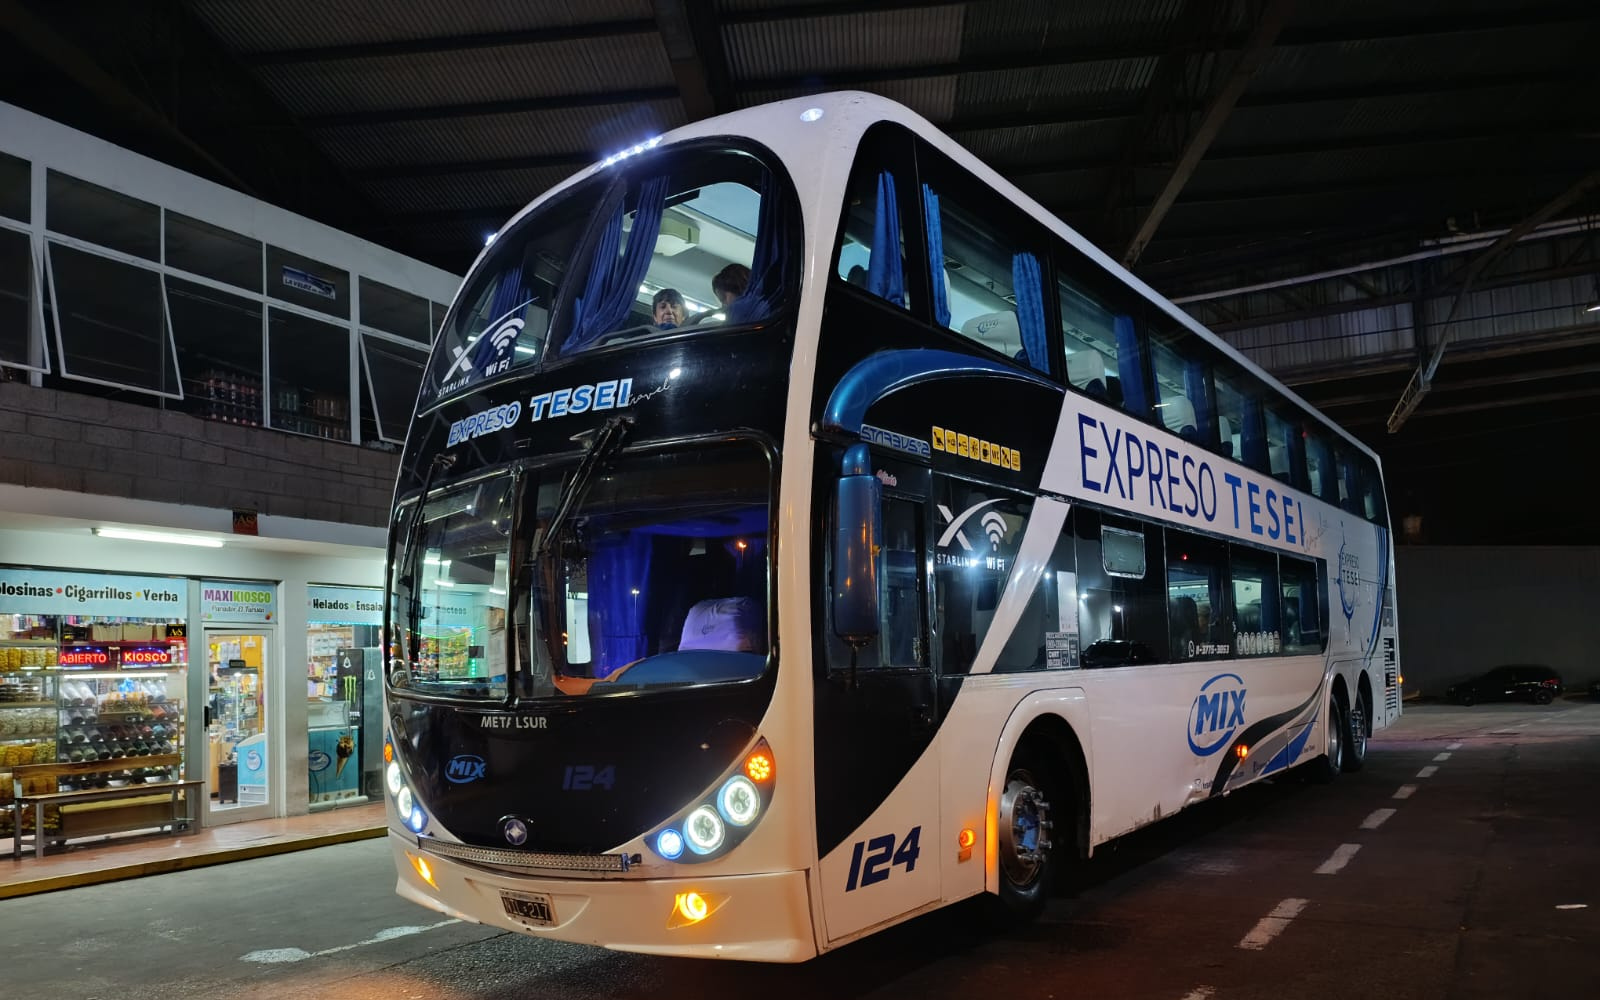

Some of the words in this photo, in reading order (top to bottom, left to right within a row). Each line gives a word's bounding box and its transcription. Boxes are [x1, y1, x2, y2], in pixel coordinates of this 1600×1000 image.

[437, 375, 471, 398] STARLINK
[446, 401, 521, 448] EXPRESO
[529, 378, 633, 422] TESEI
[1077, 412, 1217, 523] EXPRESO
[1224, 471, 1305, 546] TESEI
[936, 553, 978, 568] STARLIN
[1343, 569, 1361, 586] TESEI
[64, 585, 132, 602] Cigarrillos
[143, 589, 178, 602] Yerba
[204, 589, 271, 604] MAXIKIOSCO
[312, 598, 349, 610] Helados
[60, 653, 107, 664] ABIERTO
[124, 652, 168, 663] KIOSCO
[1194, 688, 1247, 736] MIX
[448, 759, 487, 779] MIX
[561, 765, 617, 791] 124
[845, 825, 922, 893] 124
